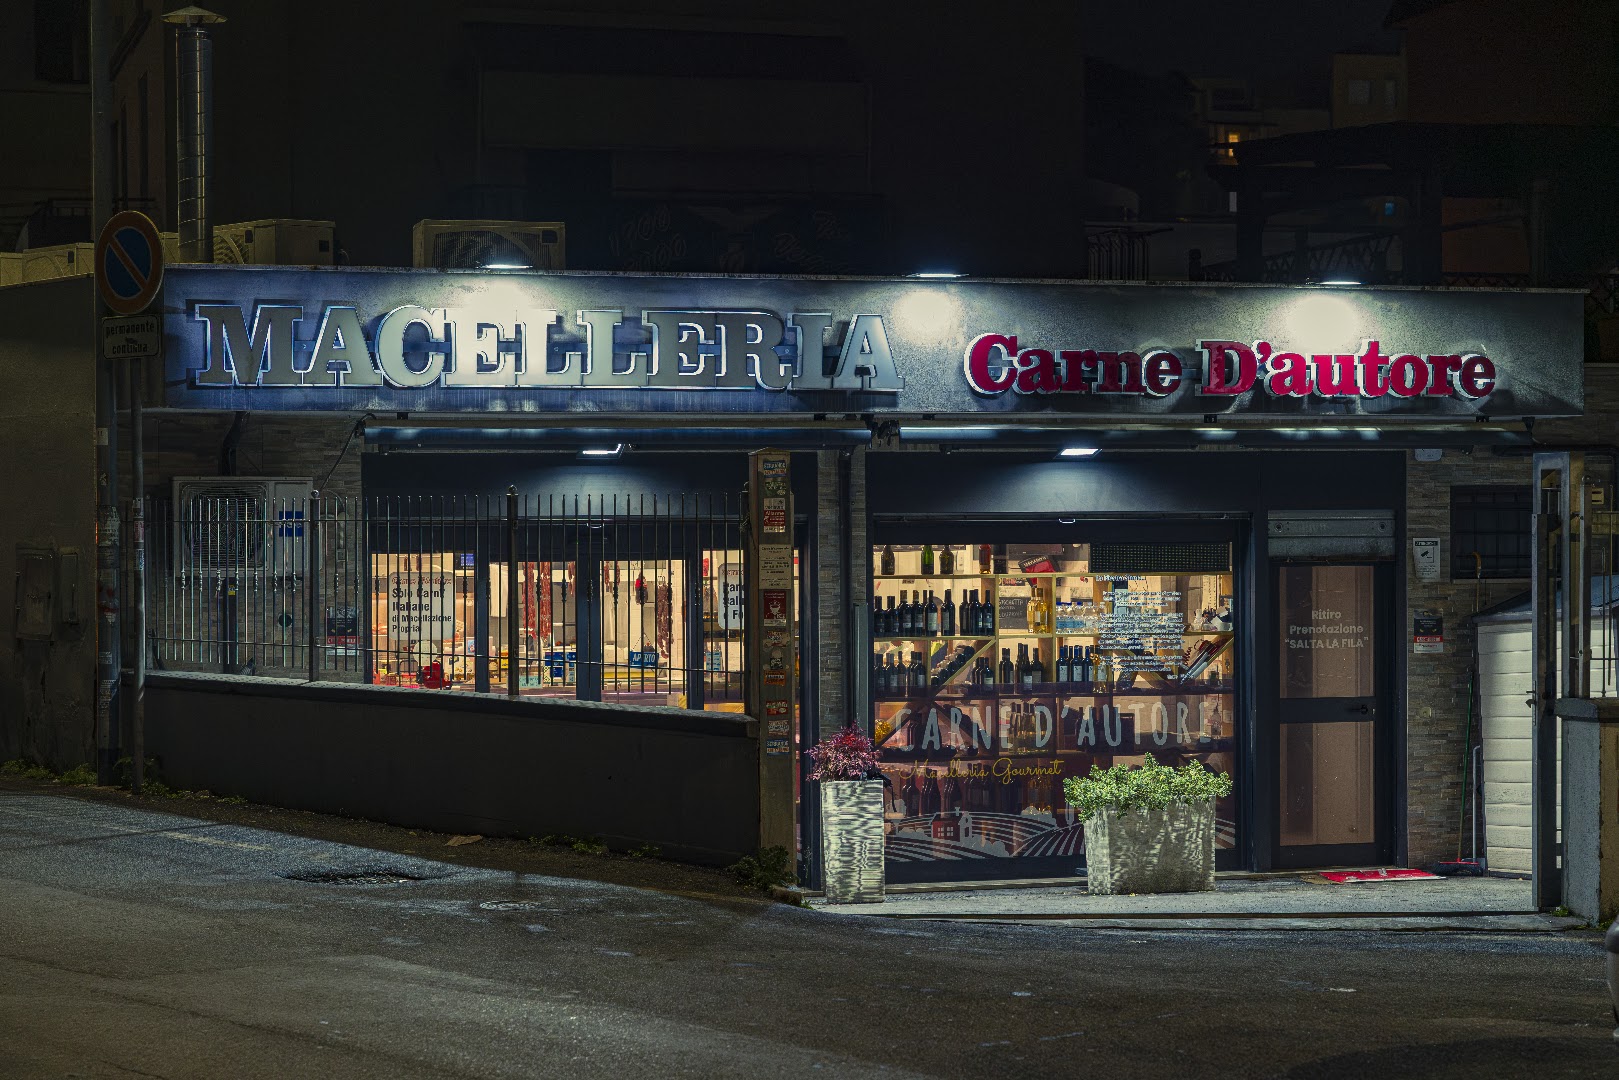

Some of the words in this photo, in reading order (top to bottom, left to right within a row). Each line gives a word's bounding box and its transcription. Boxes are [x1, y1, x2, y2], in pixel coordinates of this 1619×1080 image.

[106, 320, 155, 339] permanente
[112, 343, 148, 355] continua
[195, 304, 904, 391] MACELLERIA
[964, 333, 1182, 397] Carne
[1195, 339, 1497, 398] D'autore
[417, 588, 444, 598] Can
[1311, 609, 1342, 620] Ritiro
[392, 624, 420, 633] Popia
[1289, 622, 1364, 635] Prenotazione
[1326, 638, 1340, 649] LA
[632, 653, 656, 663] APRTO
[896, 705, 1014, 752] CARNE
[991, 757, 1065, 785] Gourmet
